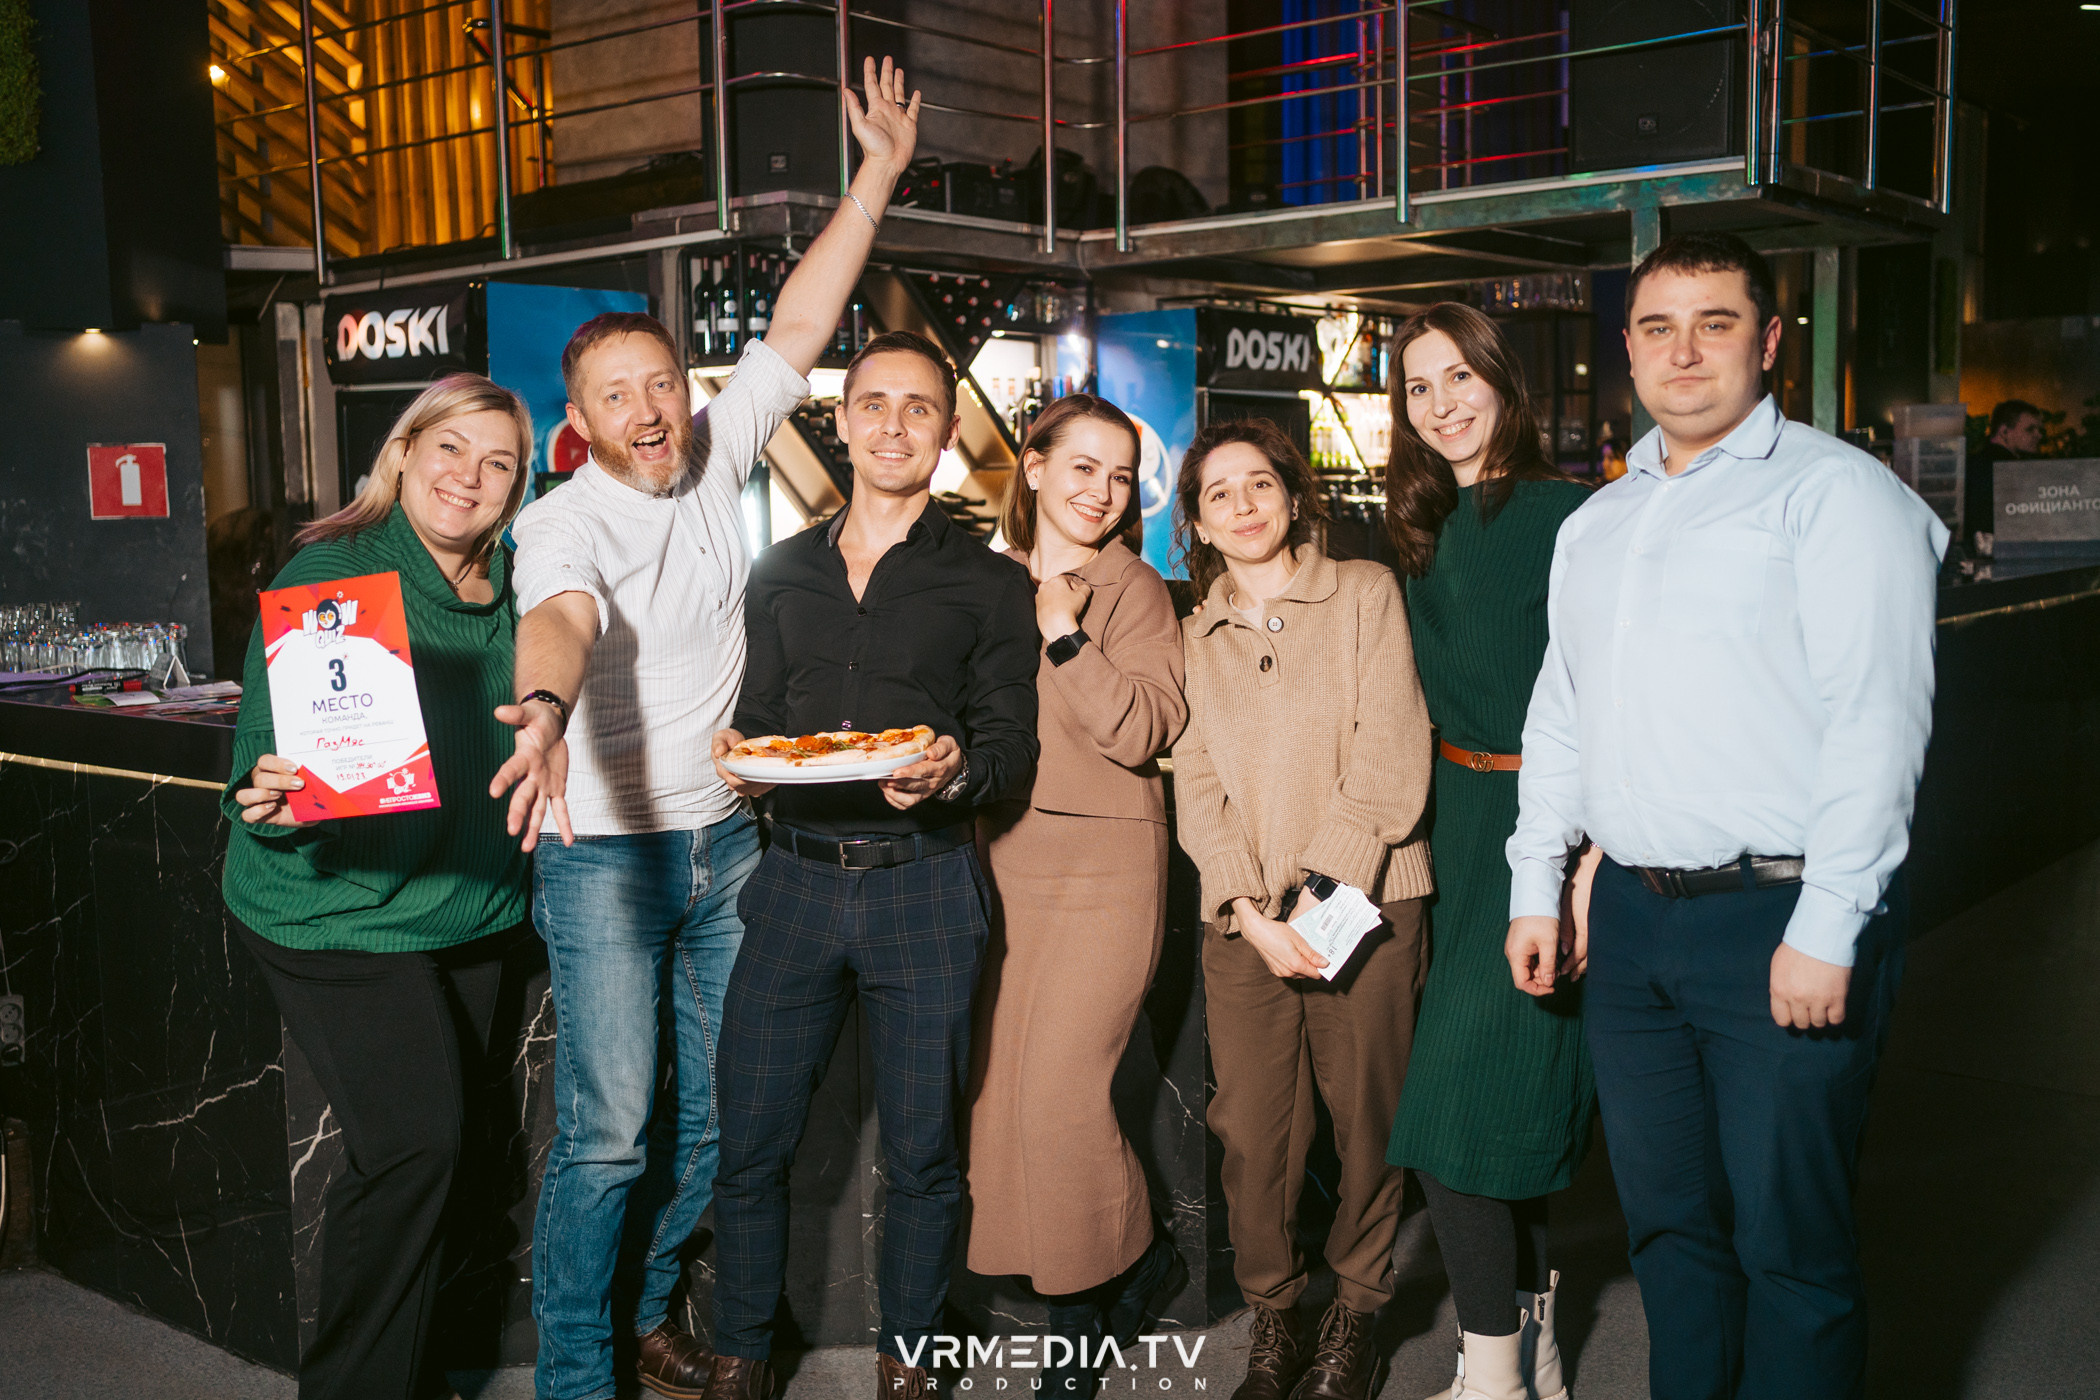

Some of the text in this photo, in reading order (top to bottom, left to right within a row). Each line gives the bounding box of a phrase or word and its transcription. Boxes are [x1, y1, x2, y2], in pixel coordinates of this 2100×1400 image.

[337, 304, 450, 362] DOSKI
[1225, 327, 1311, 373] DOSKI
[2038, 484, 2080, 498] ЗОНА
[315, 625, 346, 649] QUIZ
[329, 658, 347, 692] 3
[312, 693, 373, 714] МЕСТО
